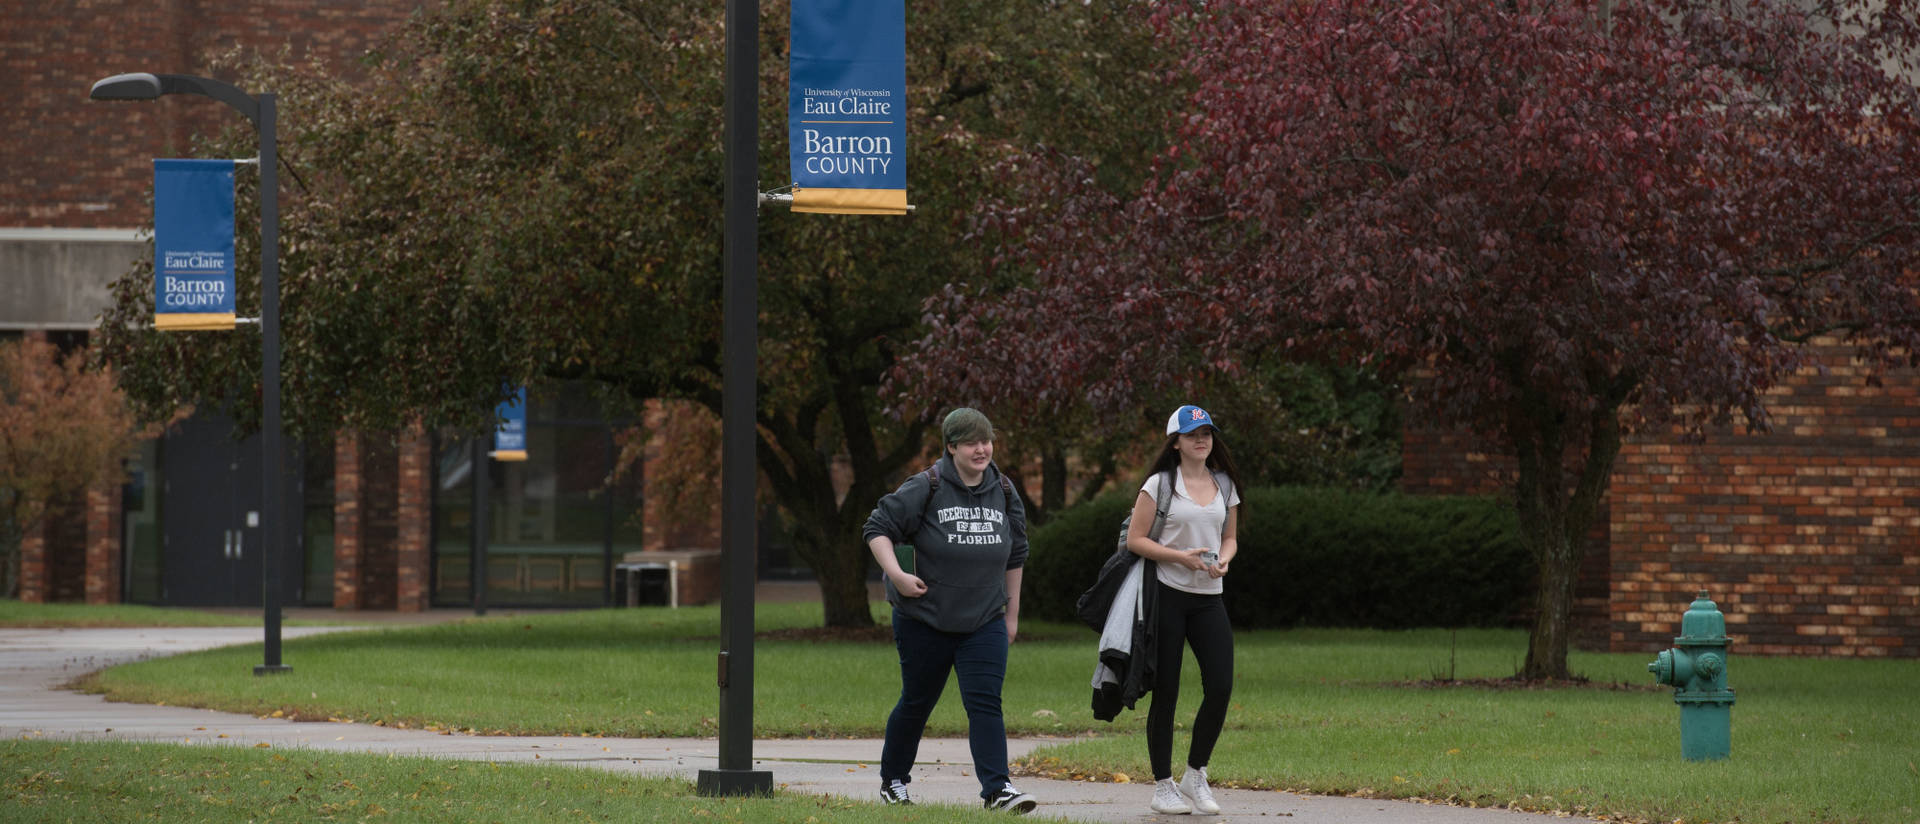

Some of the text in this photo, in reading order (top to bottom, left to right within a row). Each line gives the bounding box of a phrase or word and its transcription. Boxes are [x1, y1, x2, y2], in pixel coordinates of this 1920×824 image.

[804, 88, 891, 97] University of Wisconsin
[804, 97, 891, 115] Eau Claire
[803, 129, 893, 155] Barron
[806, 157, 891, 174] COUNTY
[165, 256, 225, 268] Eau Claire
[165, 276, 225, 293] Barron
[165, 293, 225, 306] COUNTY
[948, 534, 1002, 544] FLORIDA
